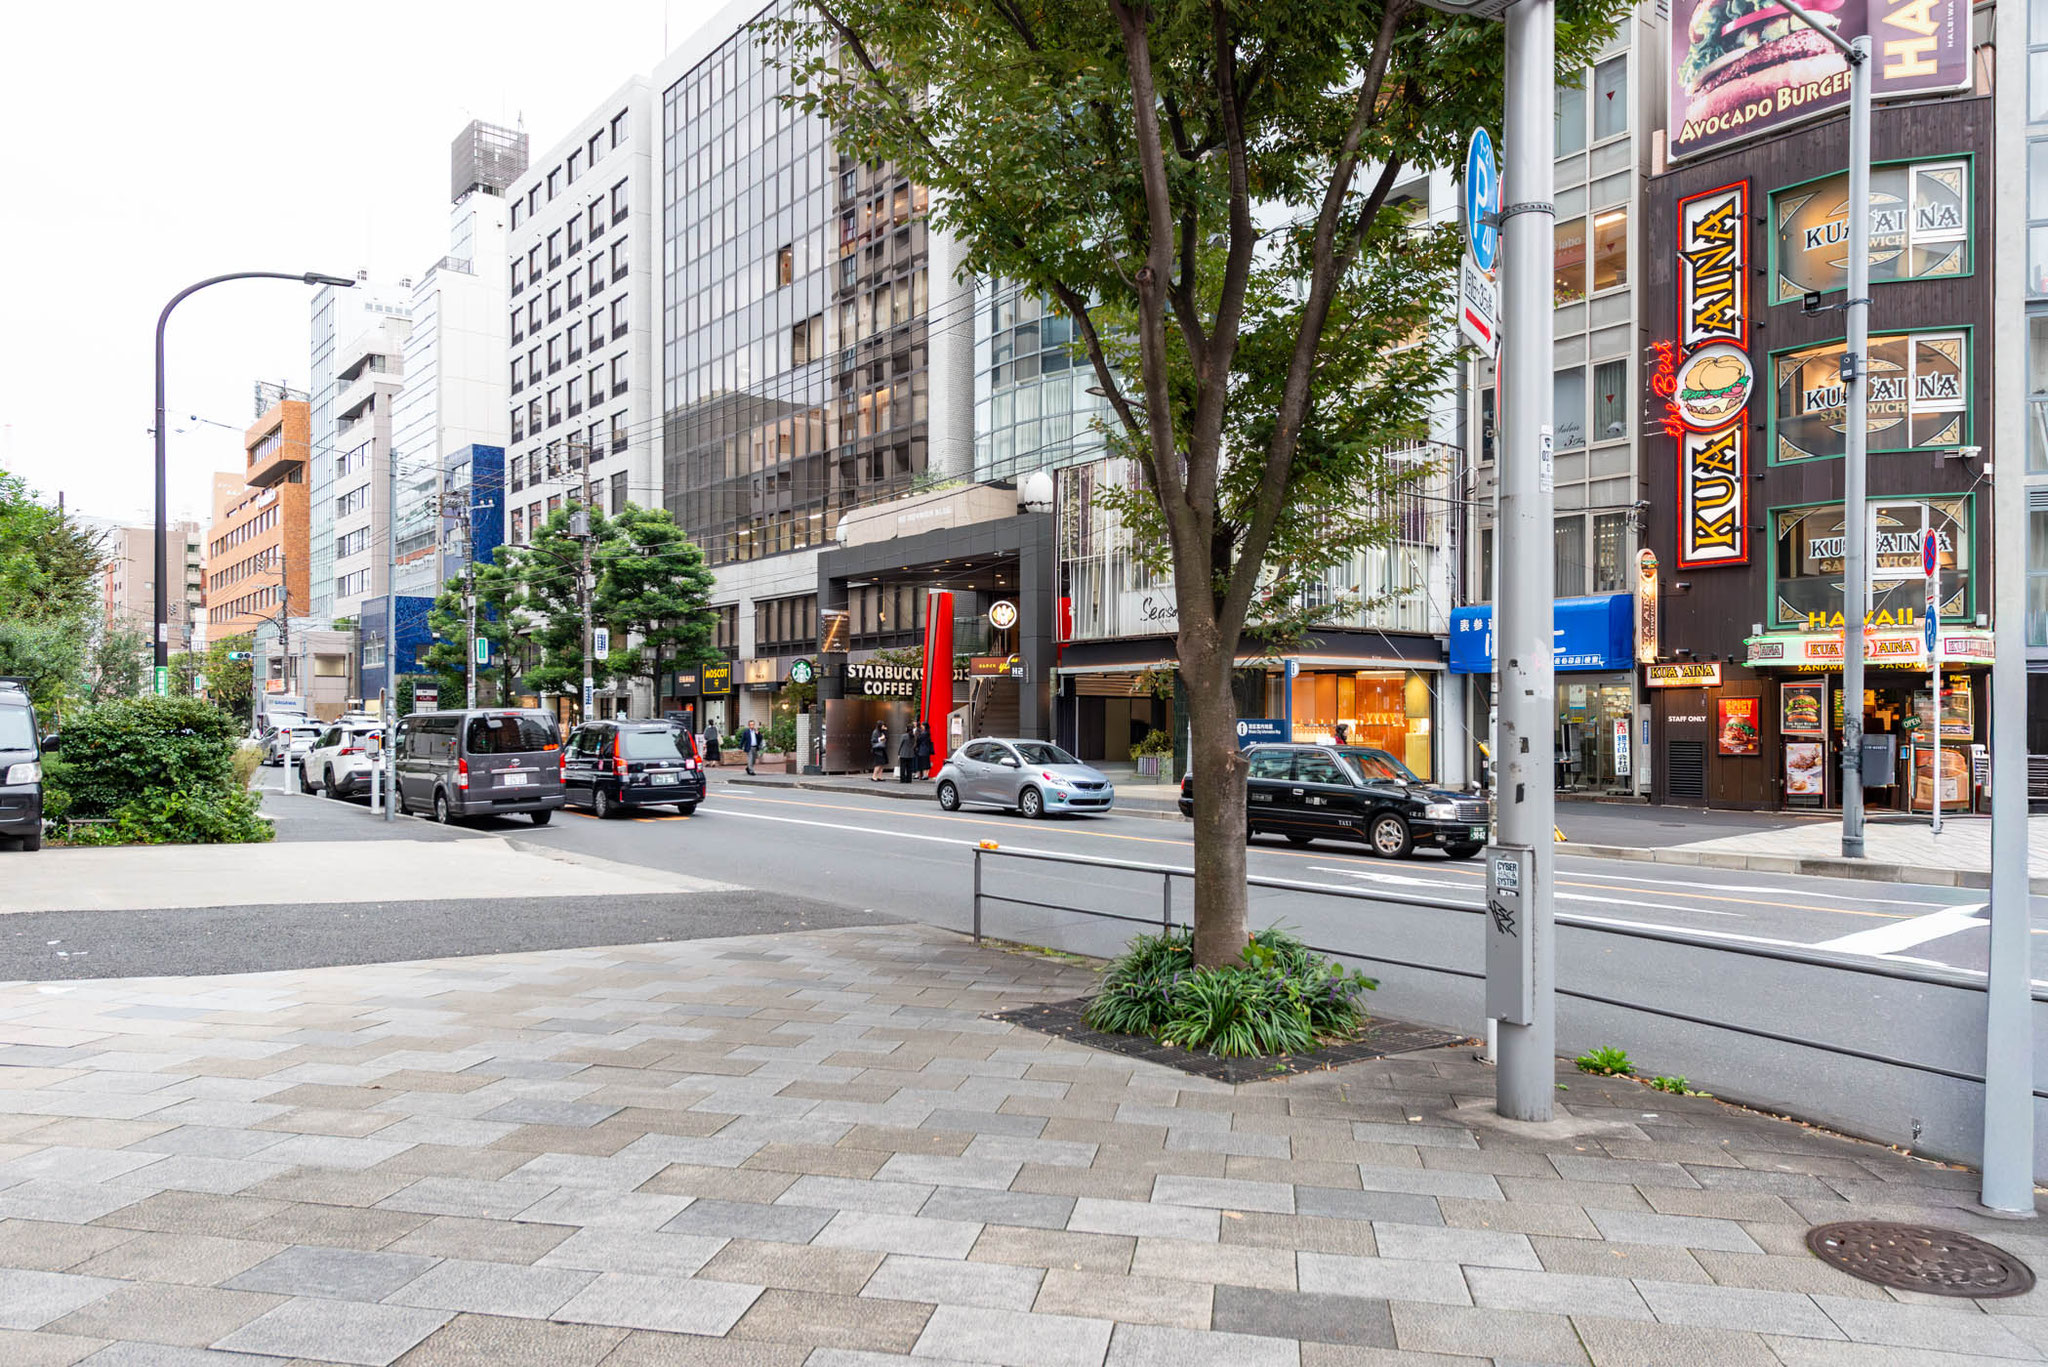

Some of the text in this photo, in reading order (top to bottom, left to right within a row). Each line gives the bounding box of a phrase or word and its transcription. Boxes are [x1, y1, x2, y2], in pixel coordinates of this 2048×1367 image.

[1882, 0, 1941, 80] HA
[1679, 98, 1773, 144] AVOCADO
[1473, 153, 1489, 238] P
[1821, 401, 1908, 422] SANWICH
[1692, 426, 1736, 553] KUA
[1811, 538, 1845, 558] KU
[1821, 555, 1922, 572] SAWICH
[1140, 596, 1178, 621] Seaso
[1810, 643, 1840, 656] KUA
[705, 668, 728, 679] MOSCOT
[1650, 666, 1678, 679] KUA
[1798, 664, 1845, 672] SANDWI
[863, 681, 914, 696] COFFEE
[1668, 715, 1707, 723] STAFF ONLY
[1903, 716, 1921, 728] OPEN
[1497, 861, 1517, 871] CYBER
[1497, 877, 1517, 887] SYSTEM
